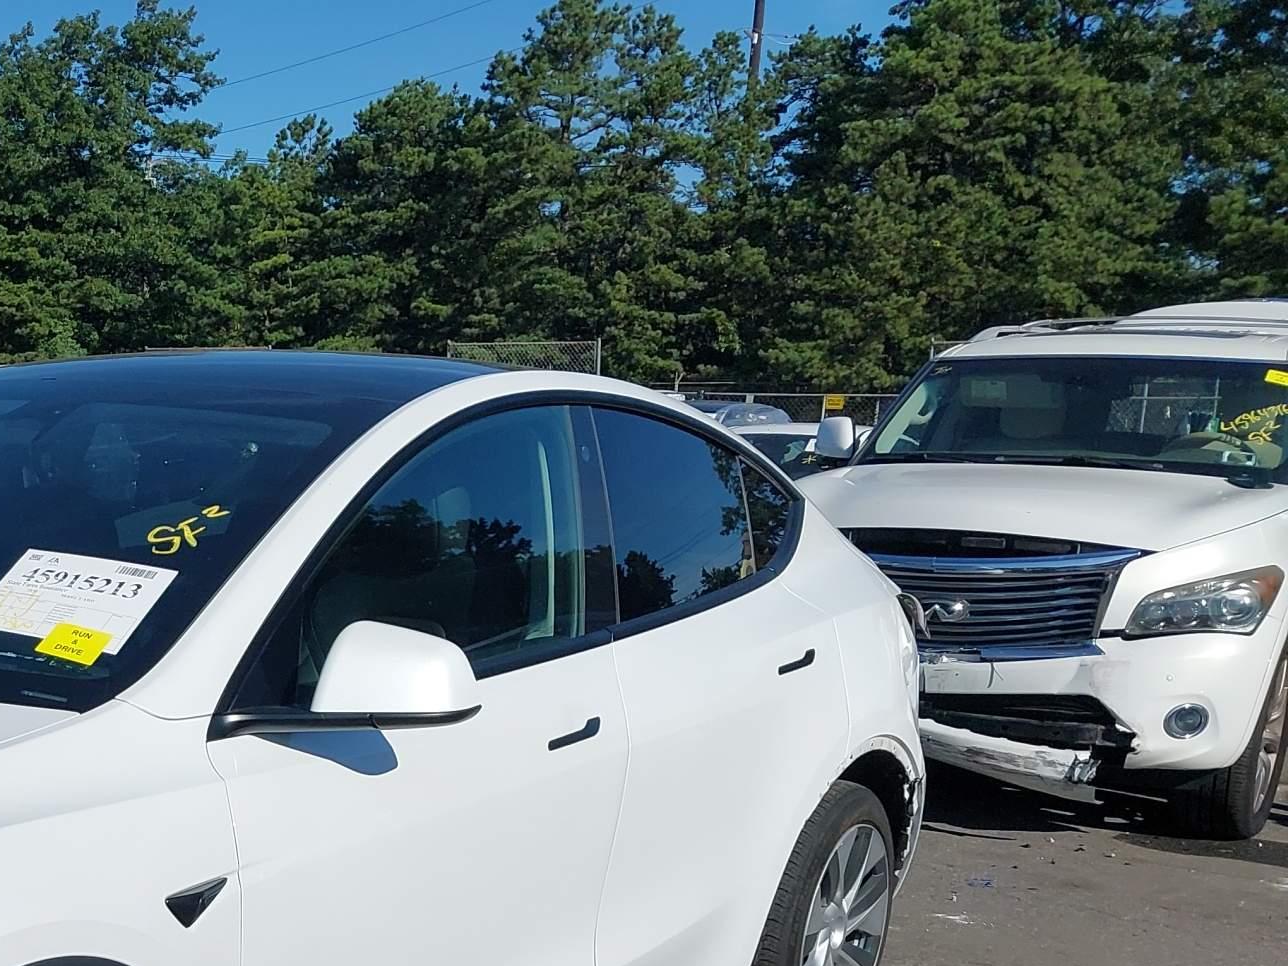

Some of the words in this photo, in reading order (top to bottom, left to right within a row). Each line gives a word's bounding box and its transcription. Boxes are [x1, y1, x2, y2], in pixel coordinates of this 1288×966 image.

[21, 567, 143, 599] 45915213
[71, 629, 93, 639] RUN
[54, 643, 84, 656] DRIVE
